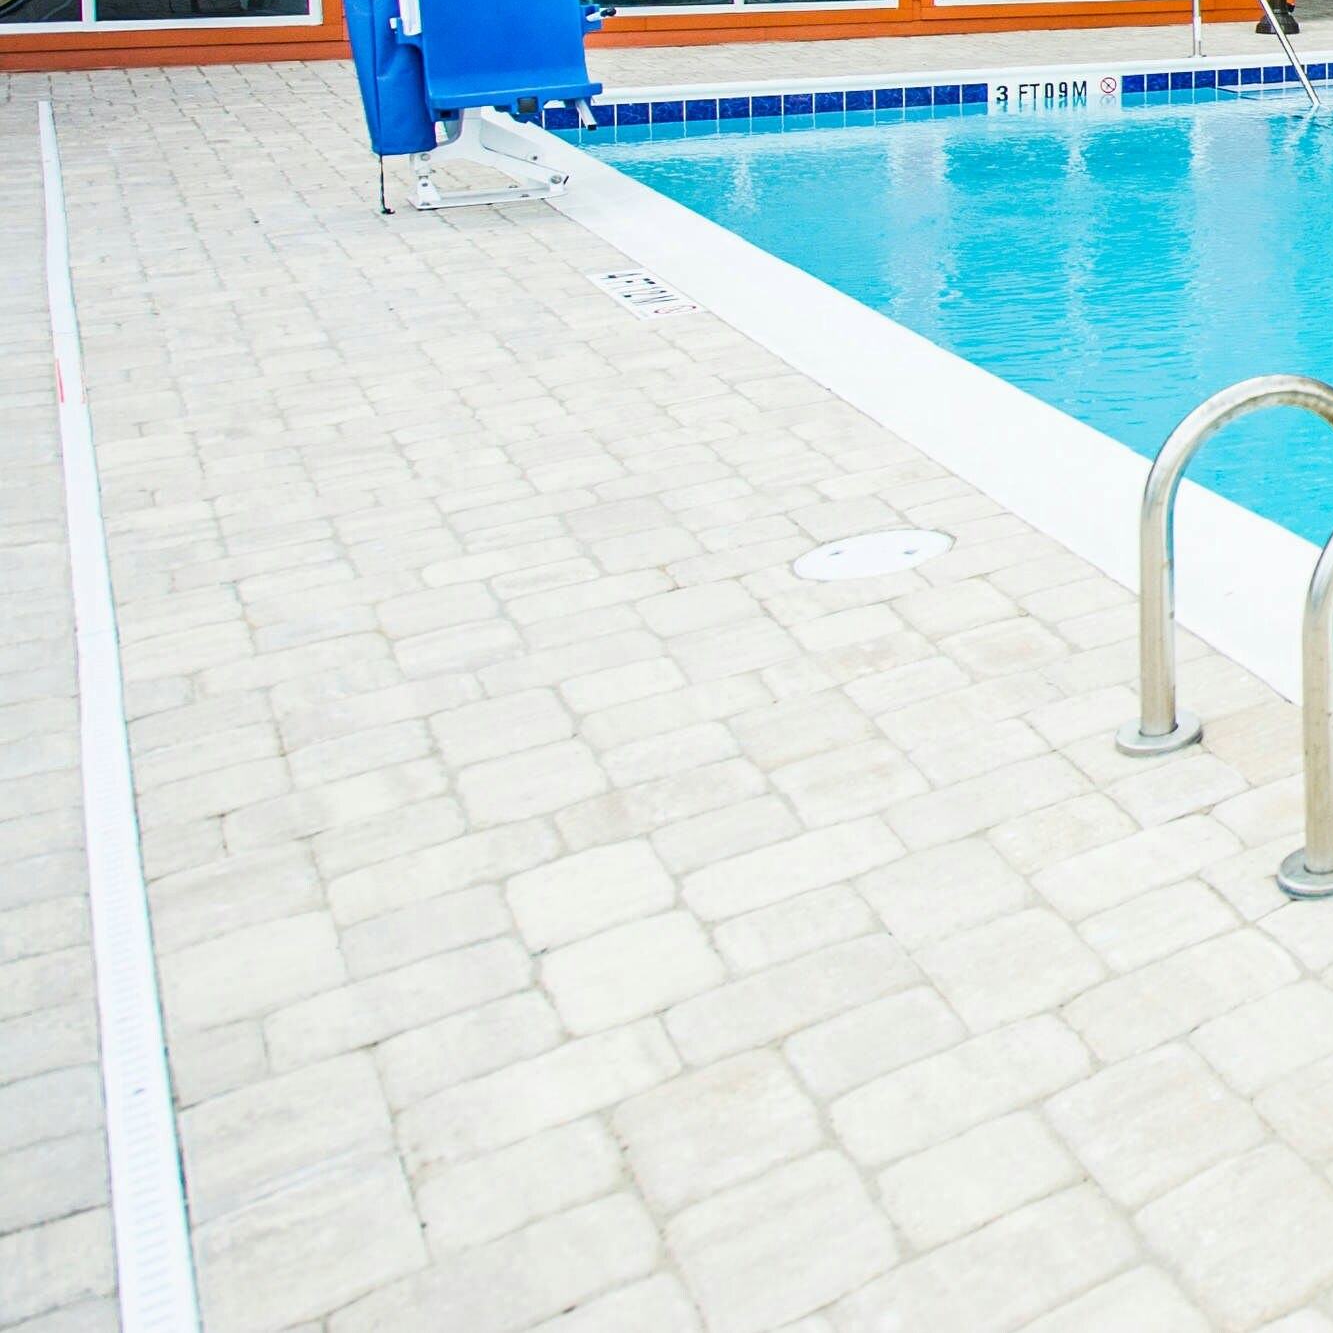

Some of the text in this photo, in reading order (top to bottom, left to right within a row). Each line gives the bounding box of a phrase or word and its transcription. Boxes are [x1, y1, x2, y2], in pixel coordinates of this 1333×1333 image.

[996, 85, 1008, 101] 3
[1018, 83, 1040, 101] FT
[1072, 80, 1087, 97] M
